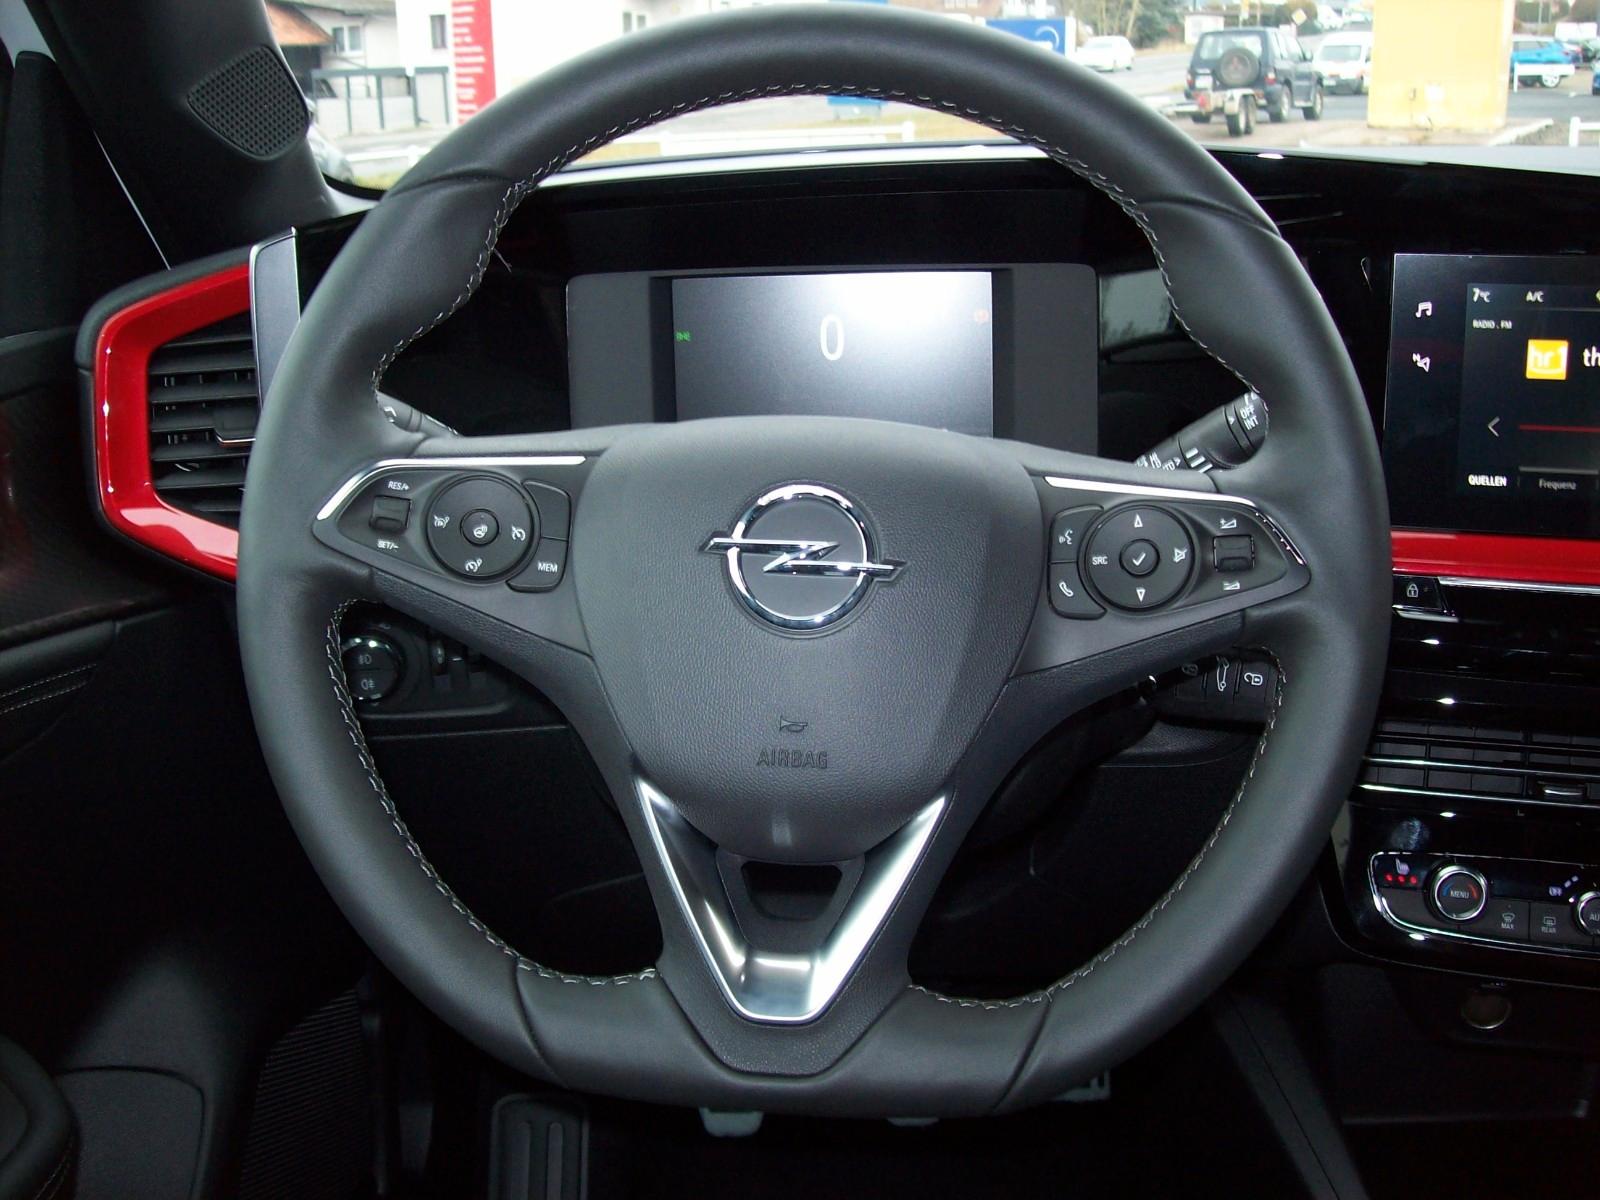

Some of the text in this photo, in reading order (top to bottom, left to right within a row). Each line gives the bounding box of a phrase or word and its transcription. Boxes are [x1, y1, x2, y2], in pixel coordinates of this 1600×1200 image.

[1526, 291, 1544, 302] A/C
[1472, 319, 1496, 329] RADIO
[820, 314, 844, 361] 0
[1240, 405, 1255, 419] OFF
[1244, 416, 1259, 430] INT
[1468, 474, 1507, 487] QUELLEN
[1092, 555, 1108, 565] SRC
[537, 561, 558, 573] MEM
[757, 748, 828, 769] AIRBAG
[1450, 889, 1470, 899] MENU
[1501, 922, 1515, 930] MAX
